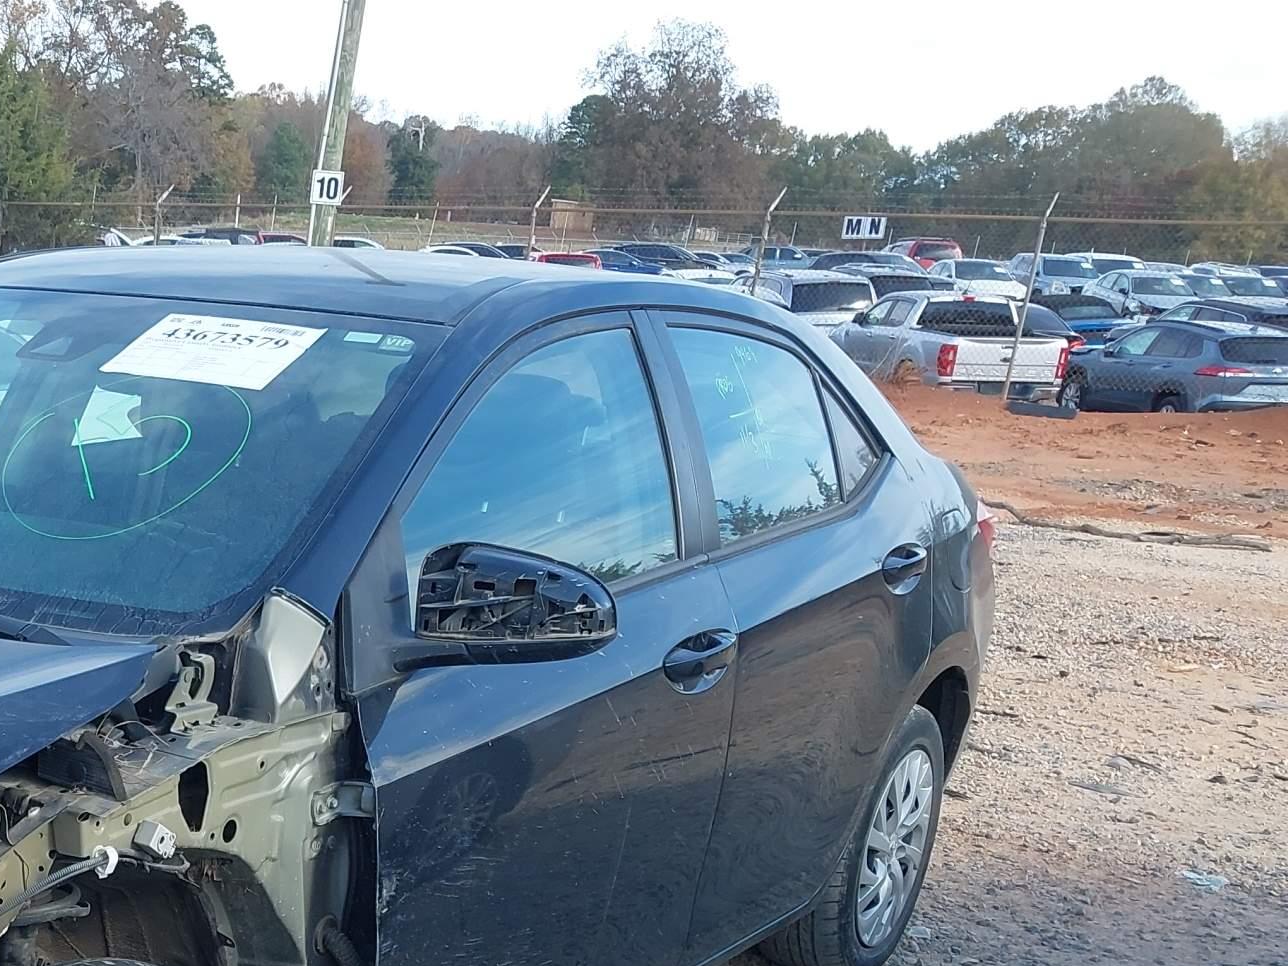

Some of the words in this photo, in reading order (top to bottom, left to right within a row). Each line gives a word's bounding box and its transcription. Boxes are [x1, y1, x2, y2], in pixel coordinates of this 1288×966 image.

[316, 176, 339, 200] 10
[845, 218, 862, 236] M
[868, 218, 882, 235] N
[161, 327, 290, 350] 43673579
[386, 337, 414, 348] VIP
